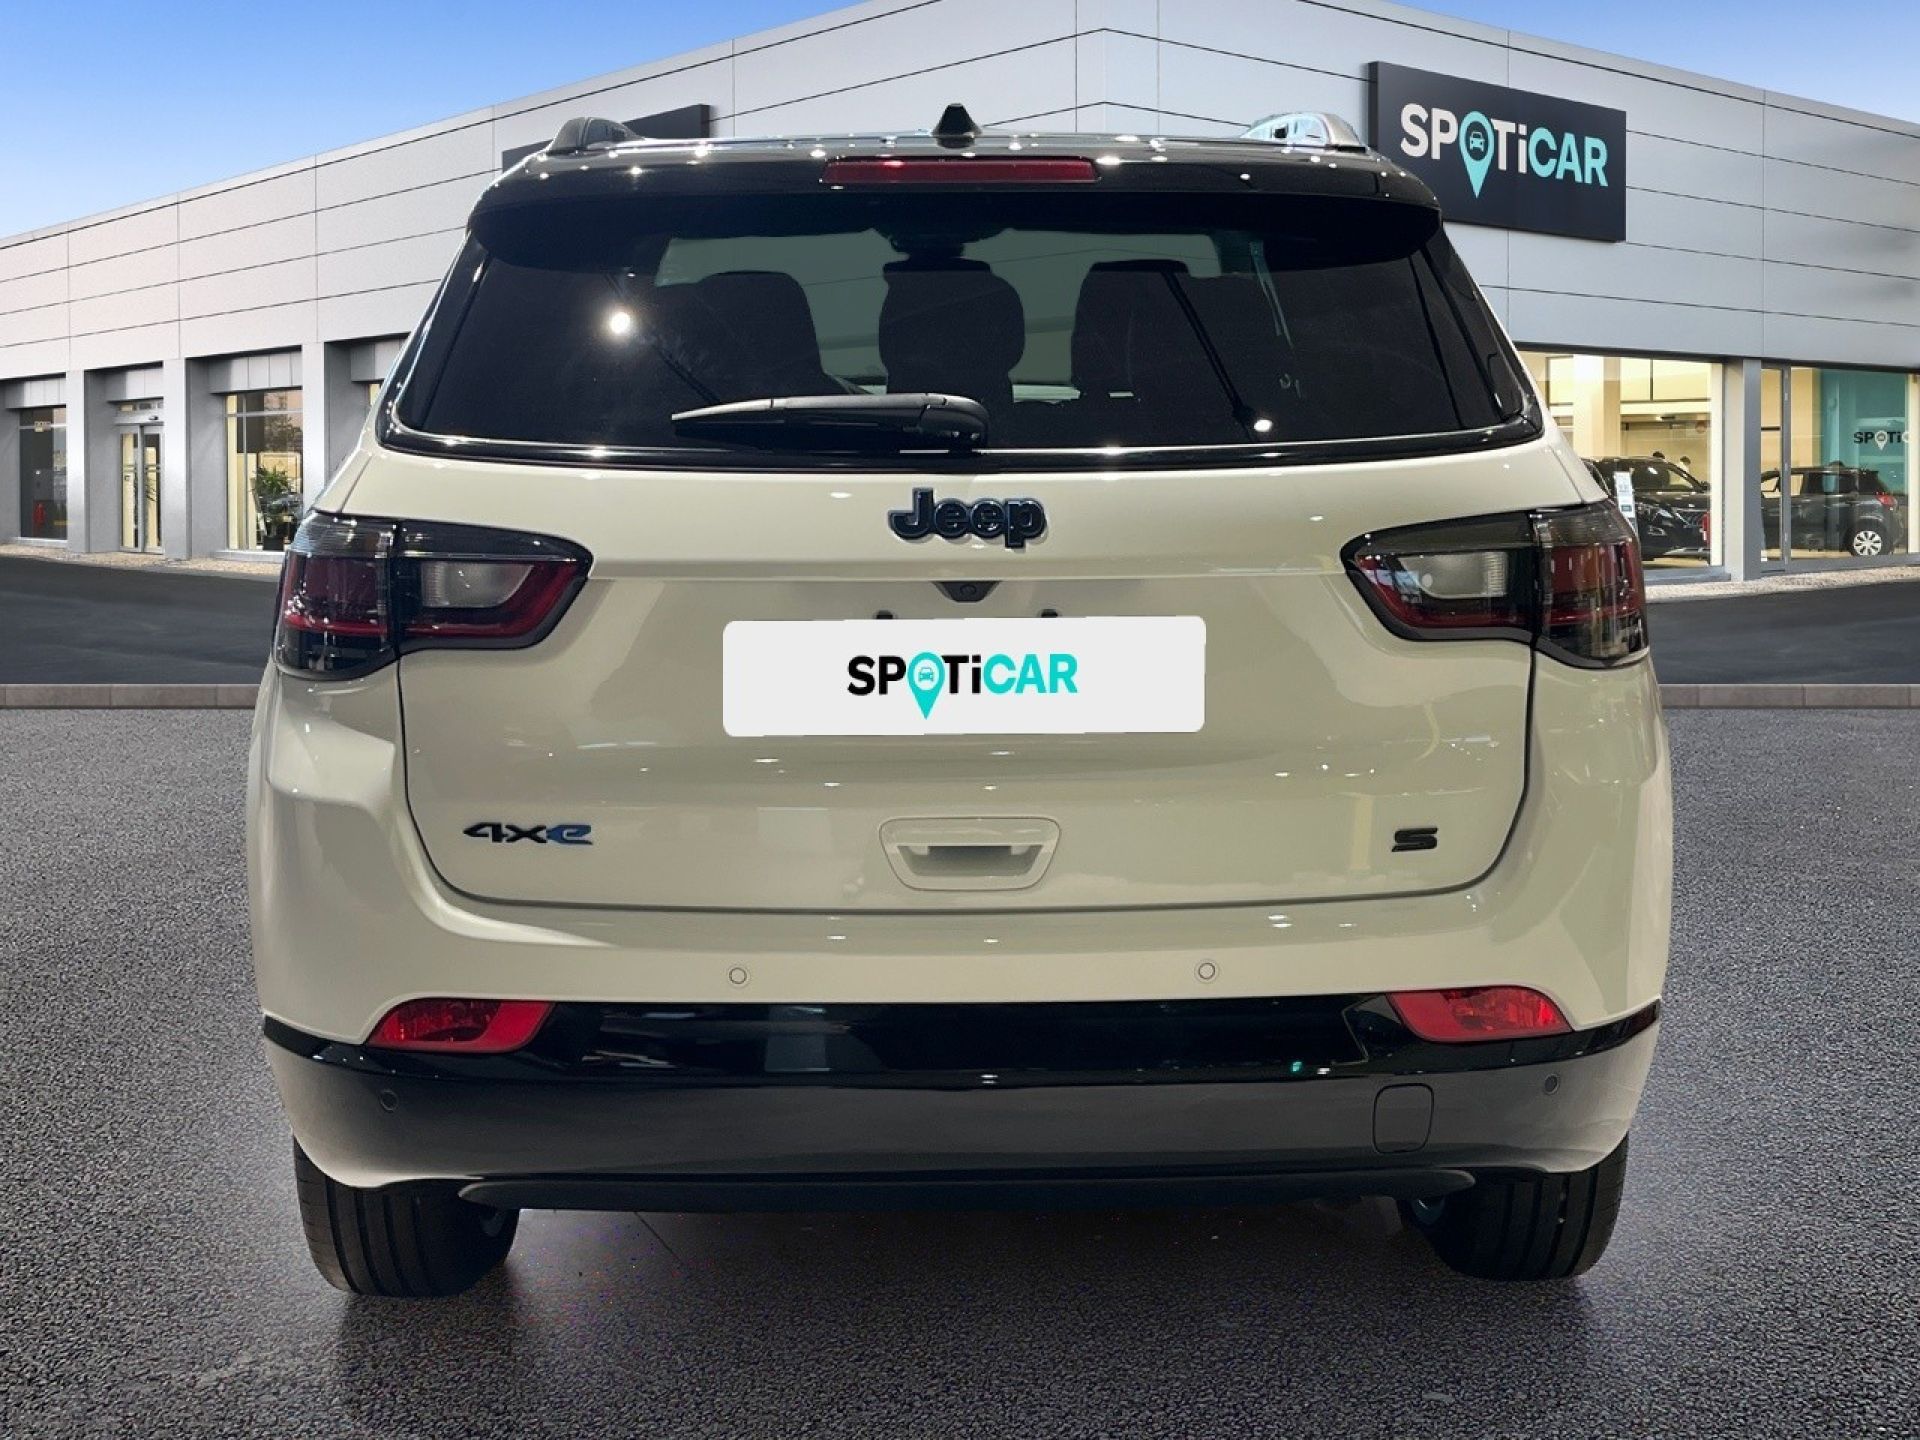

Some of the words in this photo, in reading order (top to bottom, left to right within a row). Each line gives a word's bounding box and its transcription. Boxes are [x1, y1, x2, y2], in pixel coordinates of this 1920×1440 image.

[1400, 103, 1608, 198] SPOTiCAR
[888, 487, 1047, 548] Jeep
[1392, 828, 1438, 852] S
